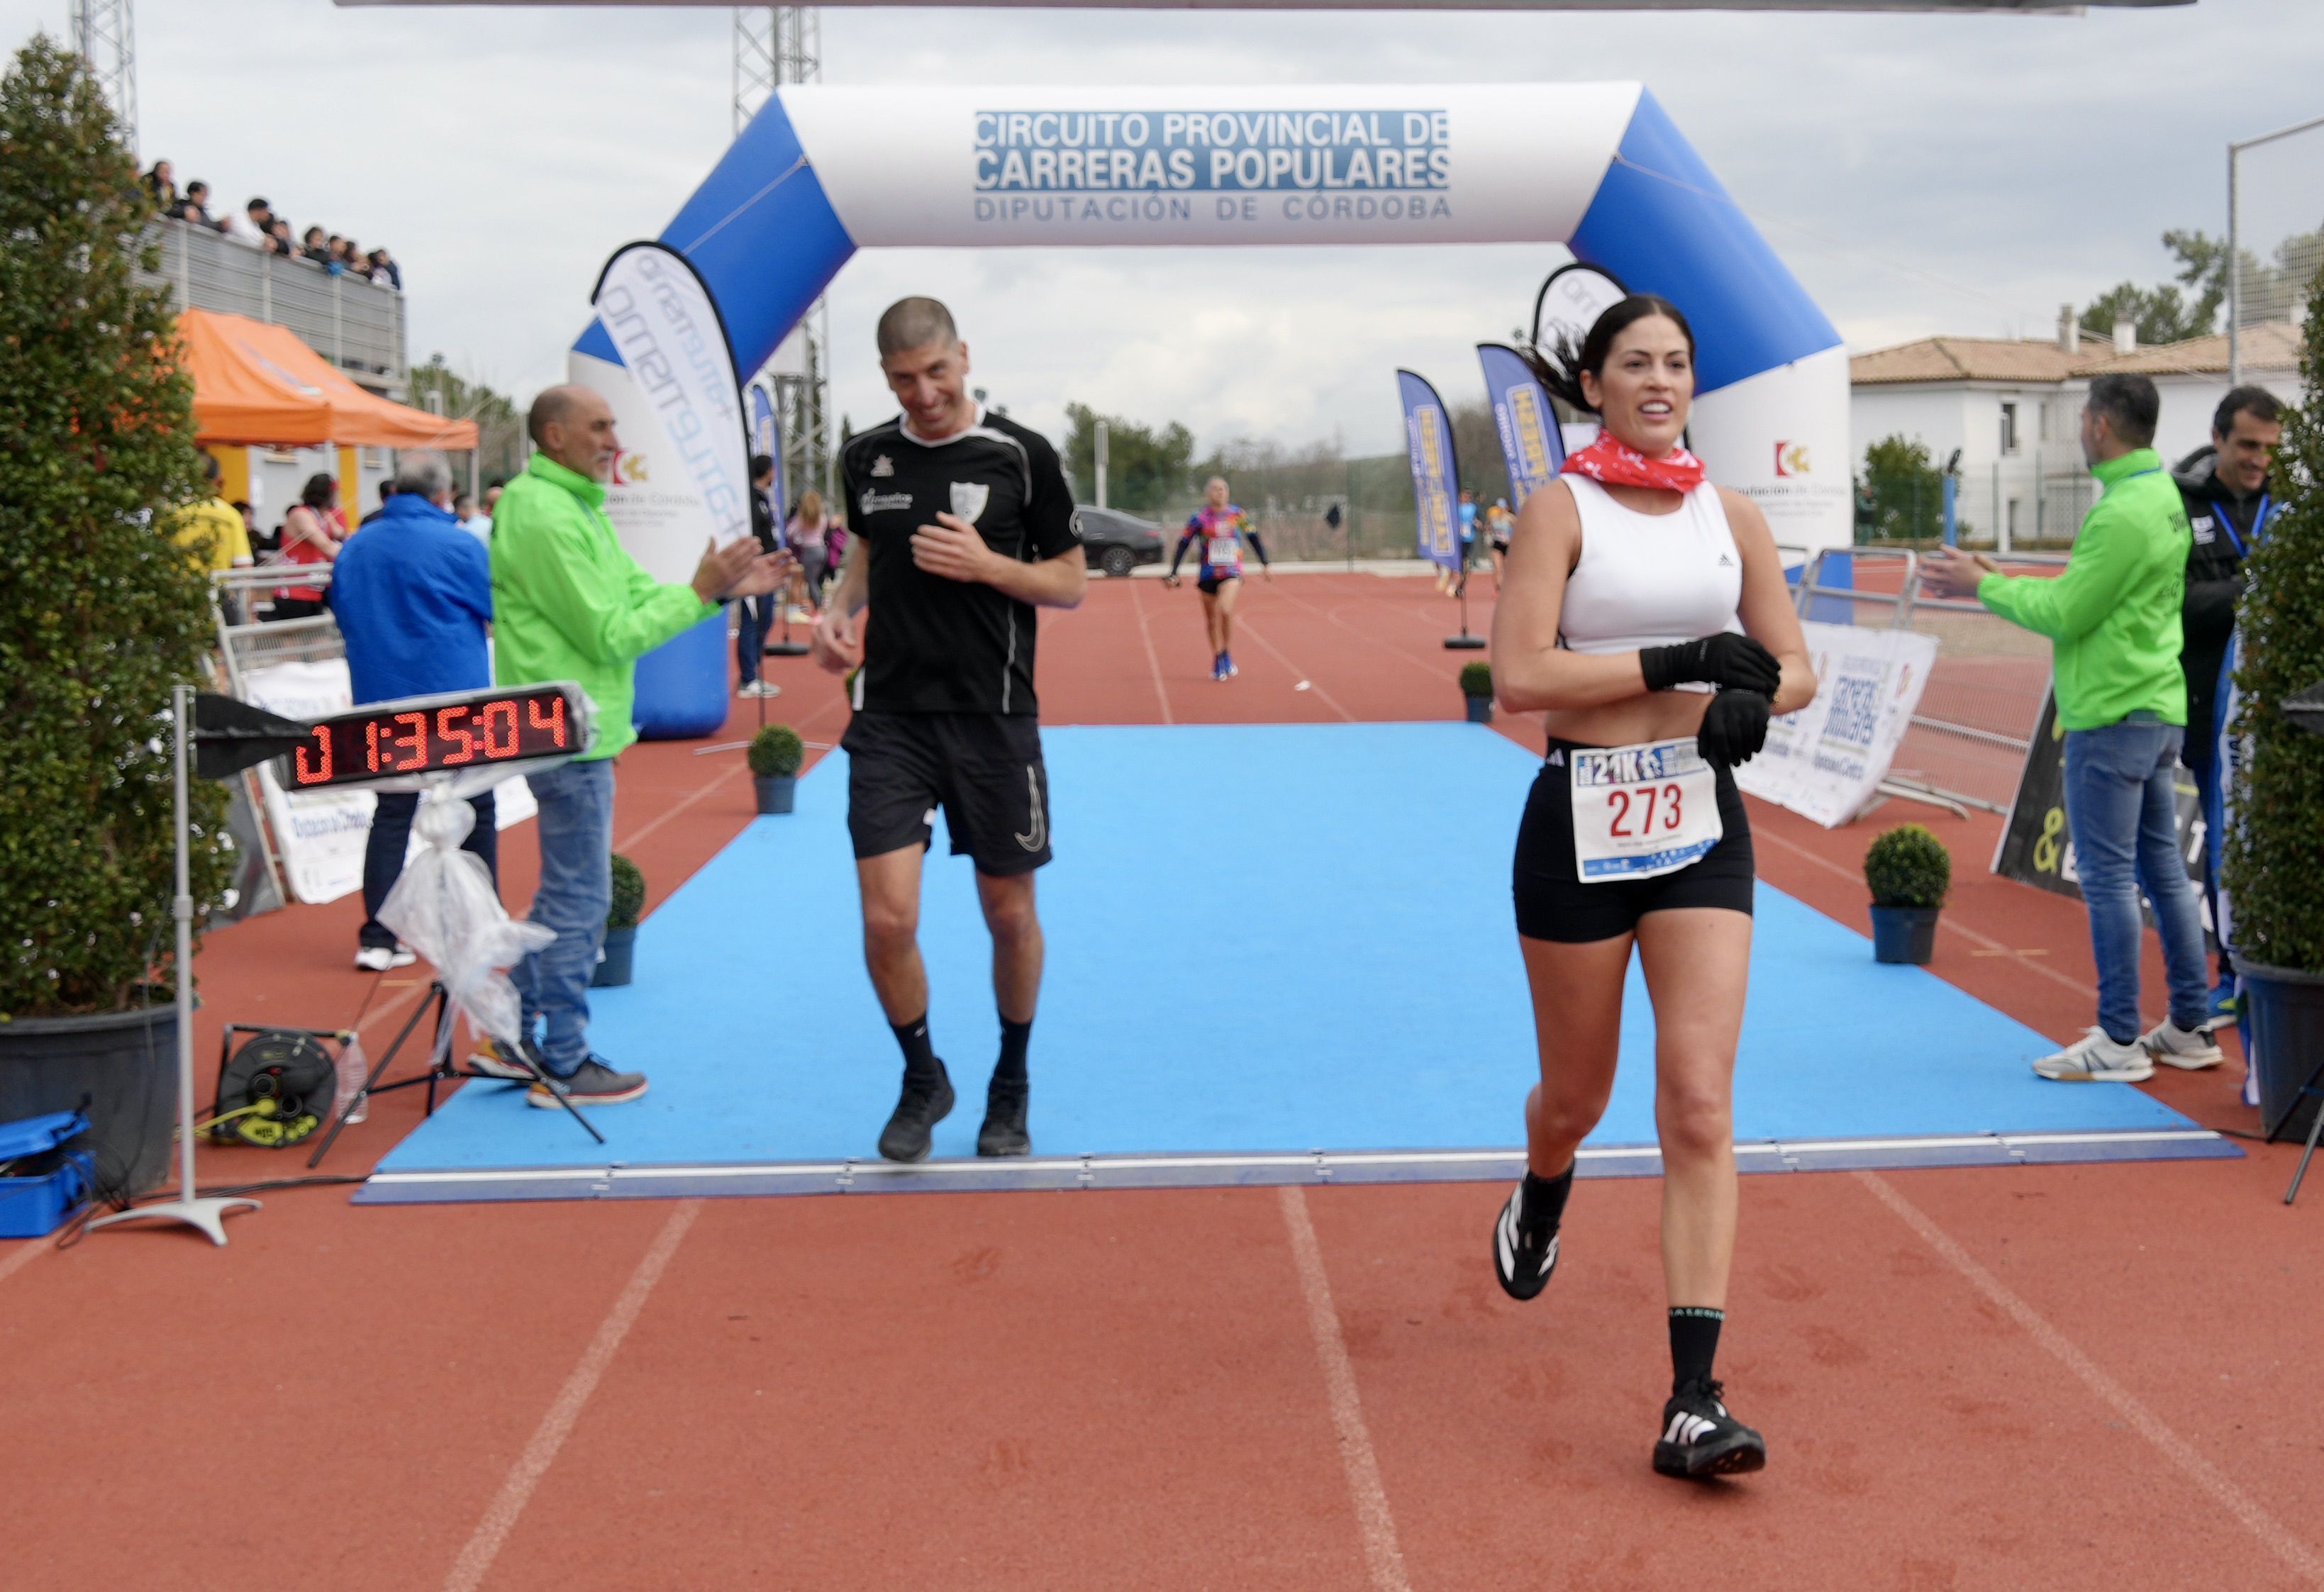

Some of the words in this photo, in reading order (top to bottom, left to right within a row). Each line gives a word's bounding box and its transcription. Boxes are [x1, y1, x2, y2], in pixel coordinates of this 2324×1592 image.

[974, 113, 1150, 147] CIRCUITO
[1163, 112, 1391, 147] PROVINCIAL
[1403, 112, 1450, 146] DE
[974, 149, 1196, 190] CARRERAS
[1210, 147, 1451, 189] POPULARES
[974, 190, 1191, 222] DIPUTACIÓN
[1216, 196, 1257, 221] DE
[1282, 189, 1452, 221] CÓRDOBA
[1607, 783, 1681, 837] 273
